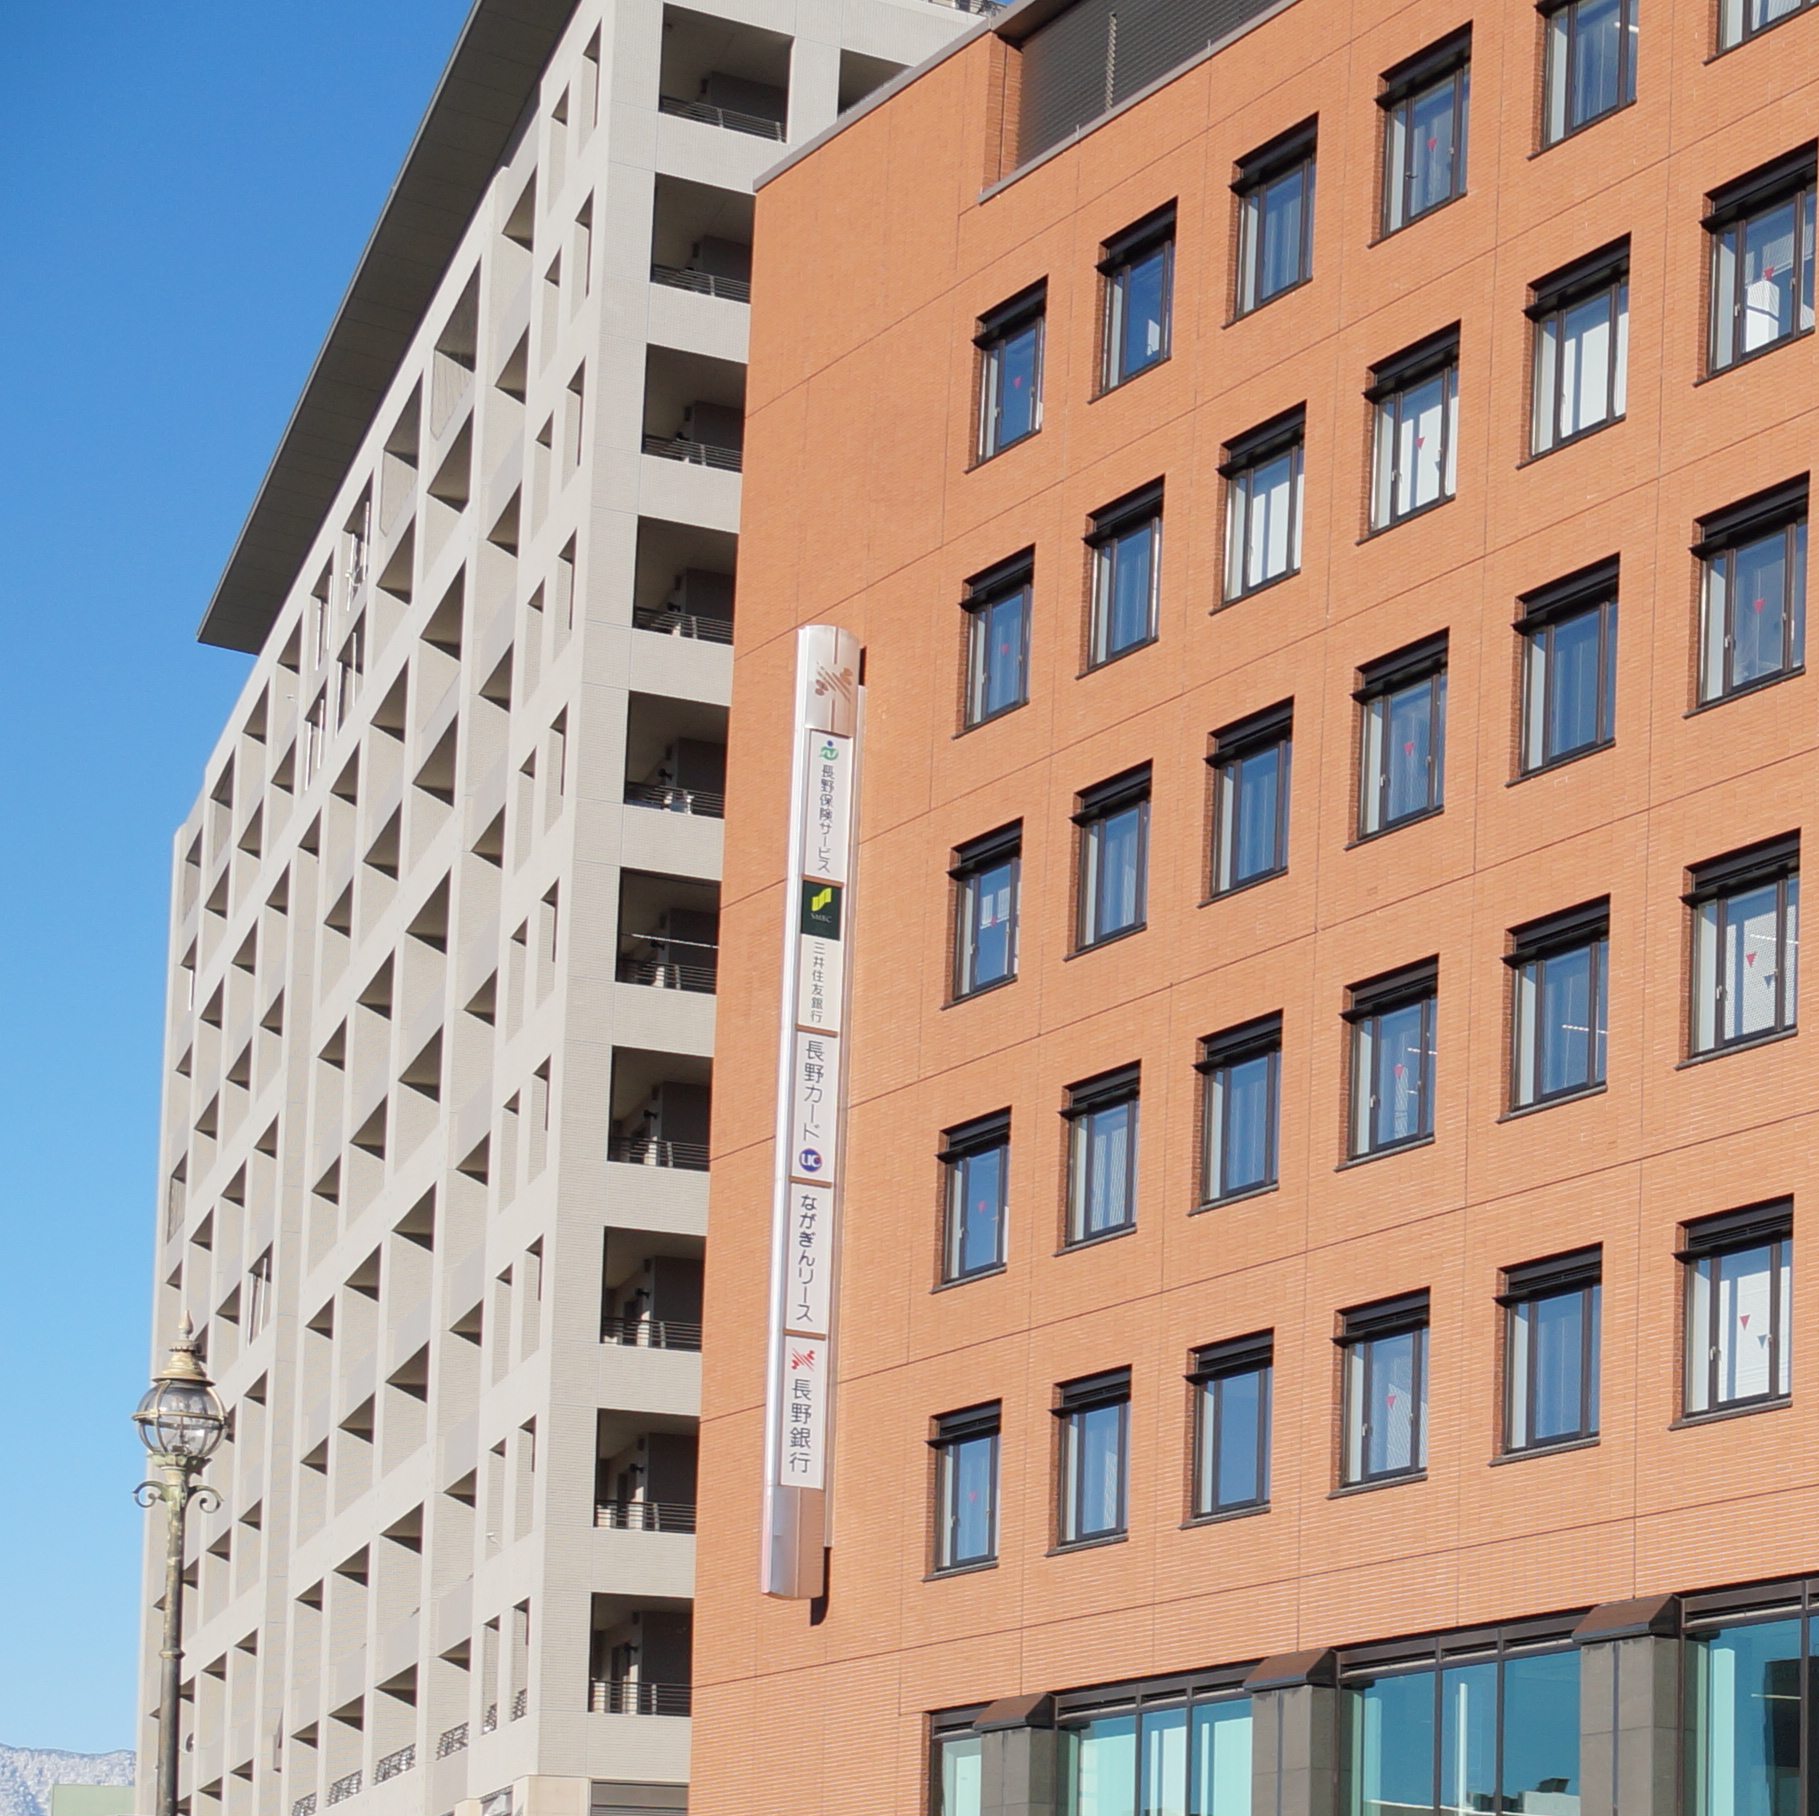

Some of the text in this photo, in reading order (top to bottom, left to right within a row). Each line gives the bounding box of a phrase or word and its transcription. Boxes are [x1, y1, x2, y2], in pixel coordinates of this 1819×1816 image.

[817, 764, 835, 873] 長野保険サービス
[810, 941, 826, 1024] 三井住友銀行
[803, 1040, 825, 1142] 長野カード
[796, 1193, 817, 1323] ながぎんリース
[789, 1379, 812, 1474] 長野銀行
